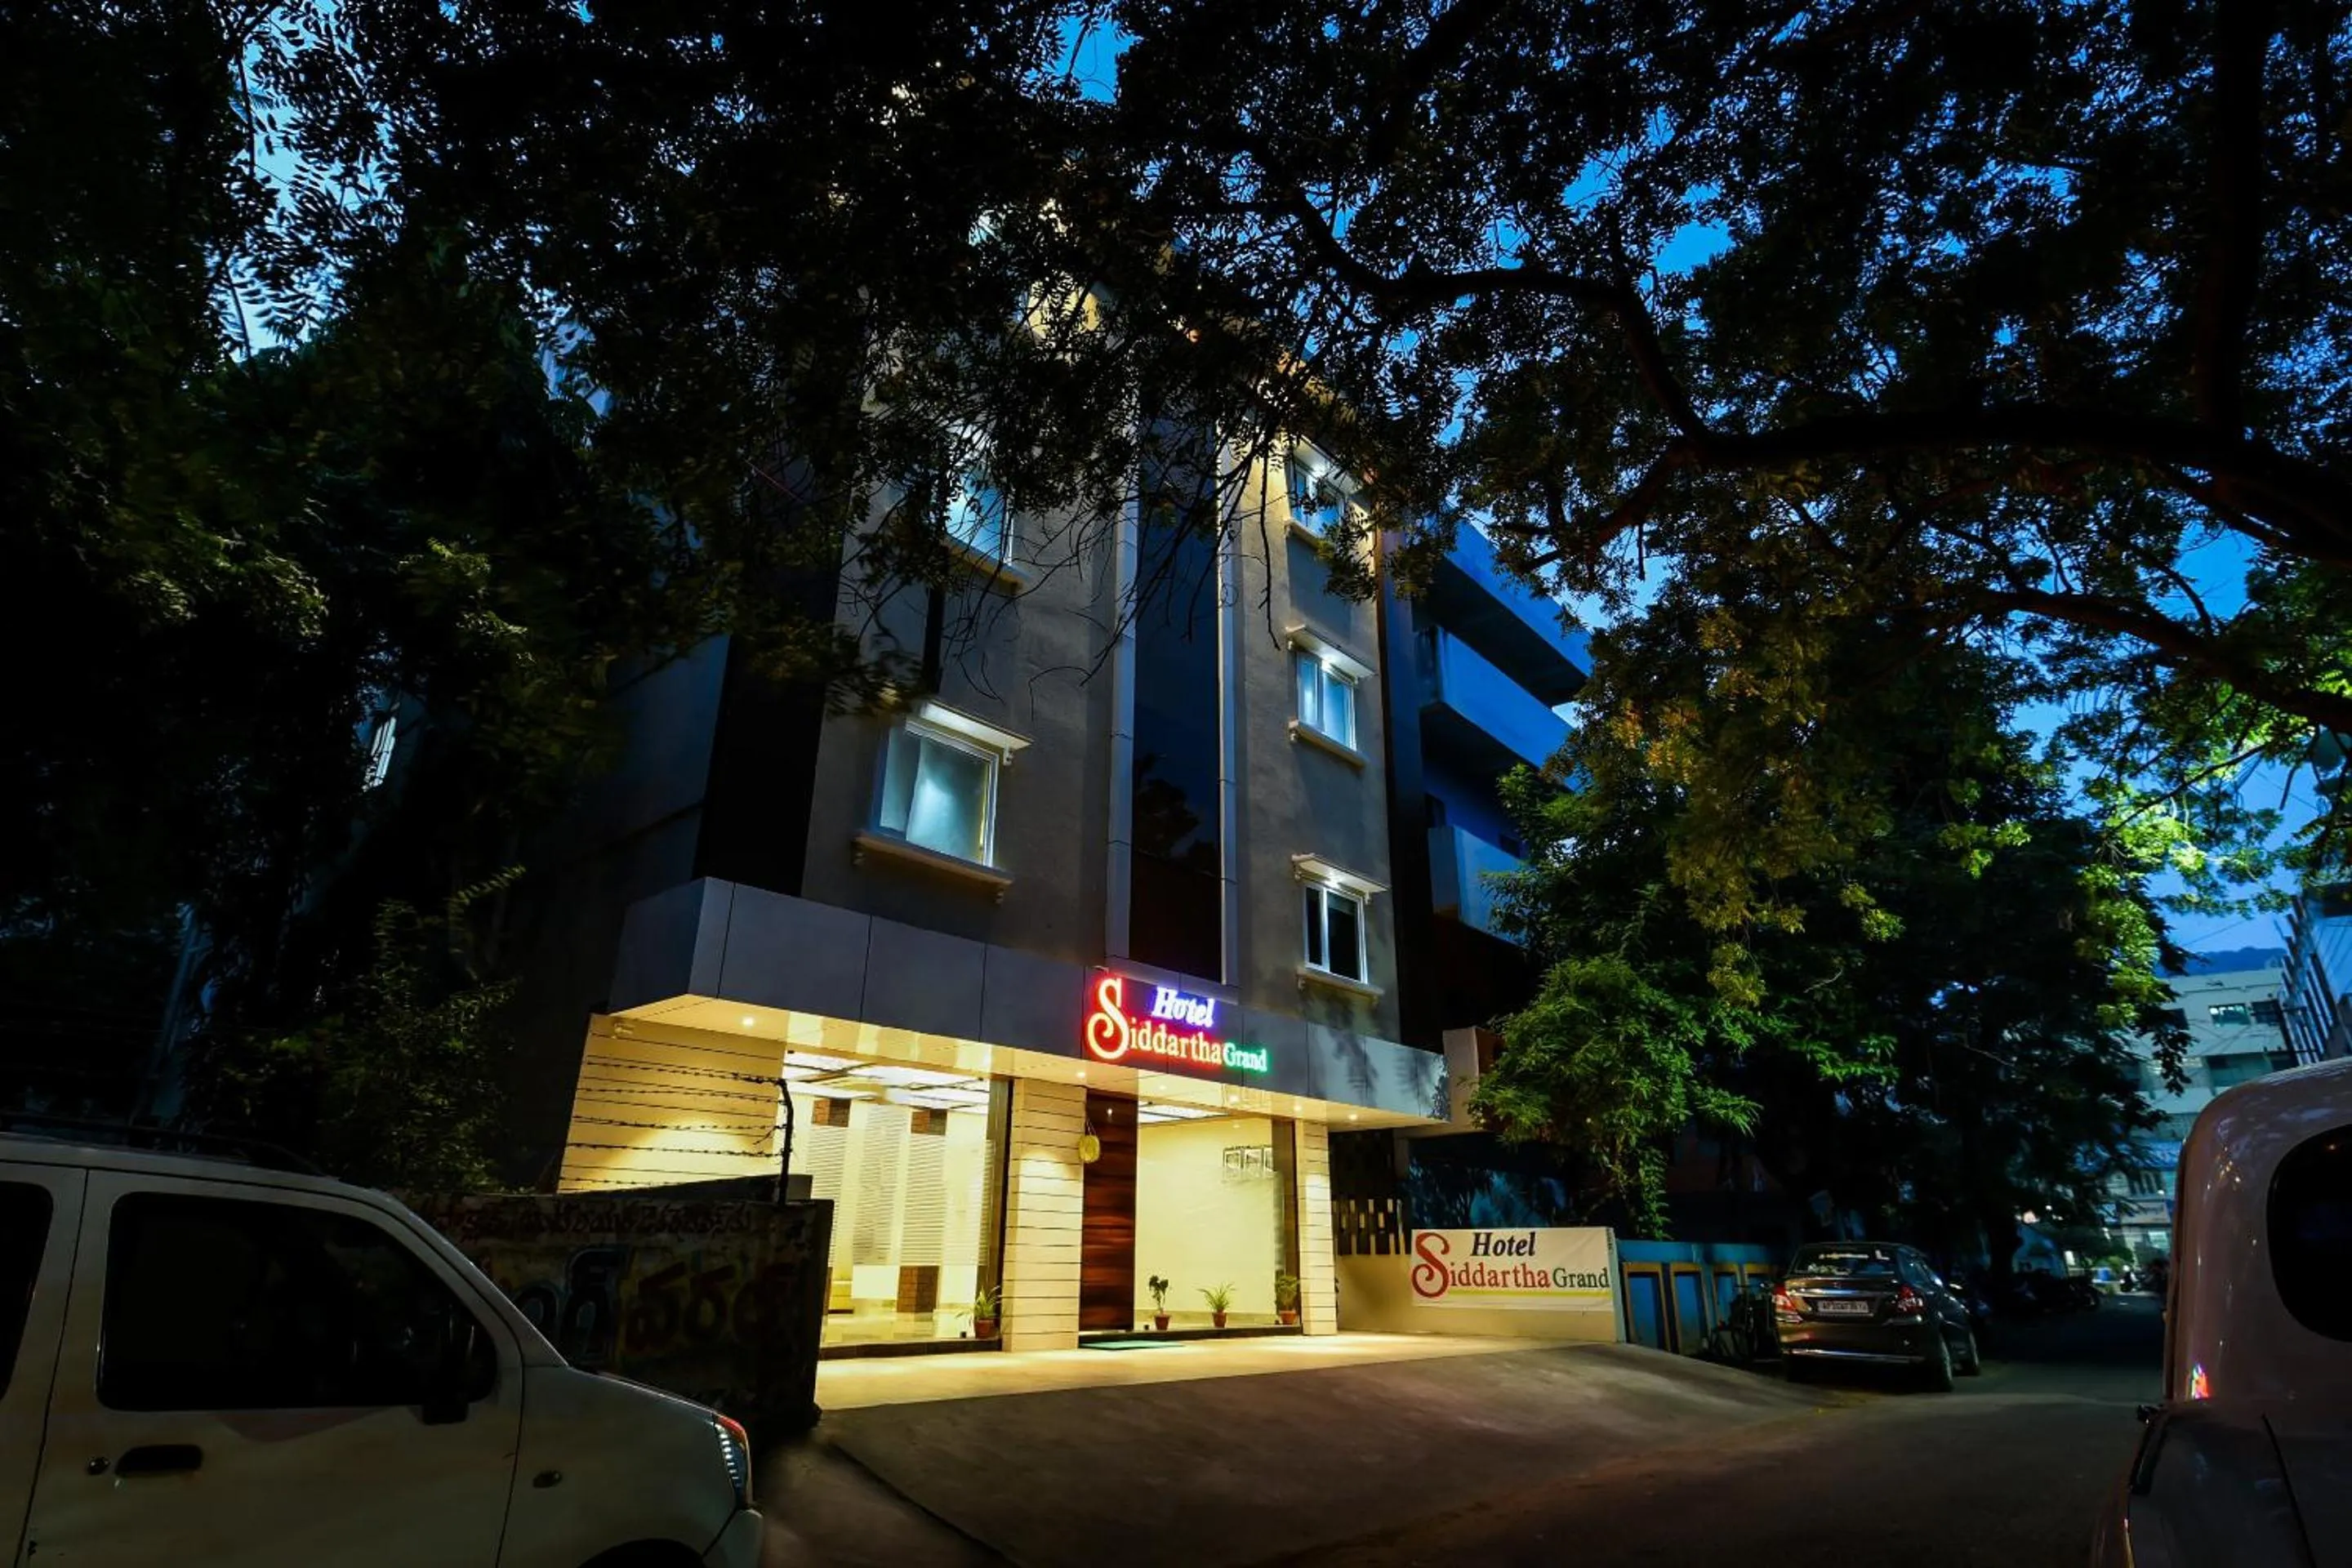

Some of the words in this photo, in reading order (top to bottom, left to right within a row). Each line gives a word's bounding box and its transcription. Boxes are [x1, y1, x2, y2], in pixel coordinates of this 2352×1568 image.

[1087, 978, 1223, 1065] Siddartha
[1223, 1042, 1267, 1071] Grand
[1152, 987, 1214, 1027] Hotel
[1411, 1232, 1550, 1297] Siddartha
[1552, 1267, 1610, 1288] Grand
[1471, 1232, 1535, 1256] Hotel
